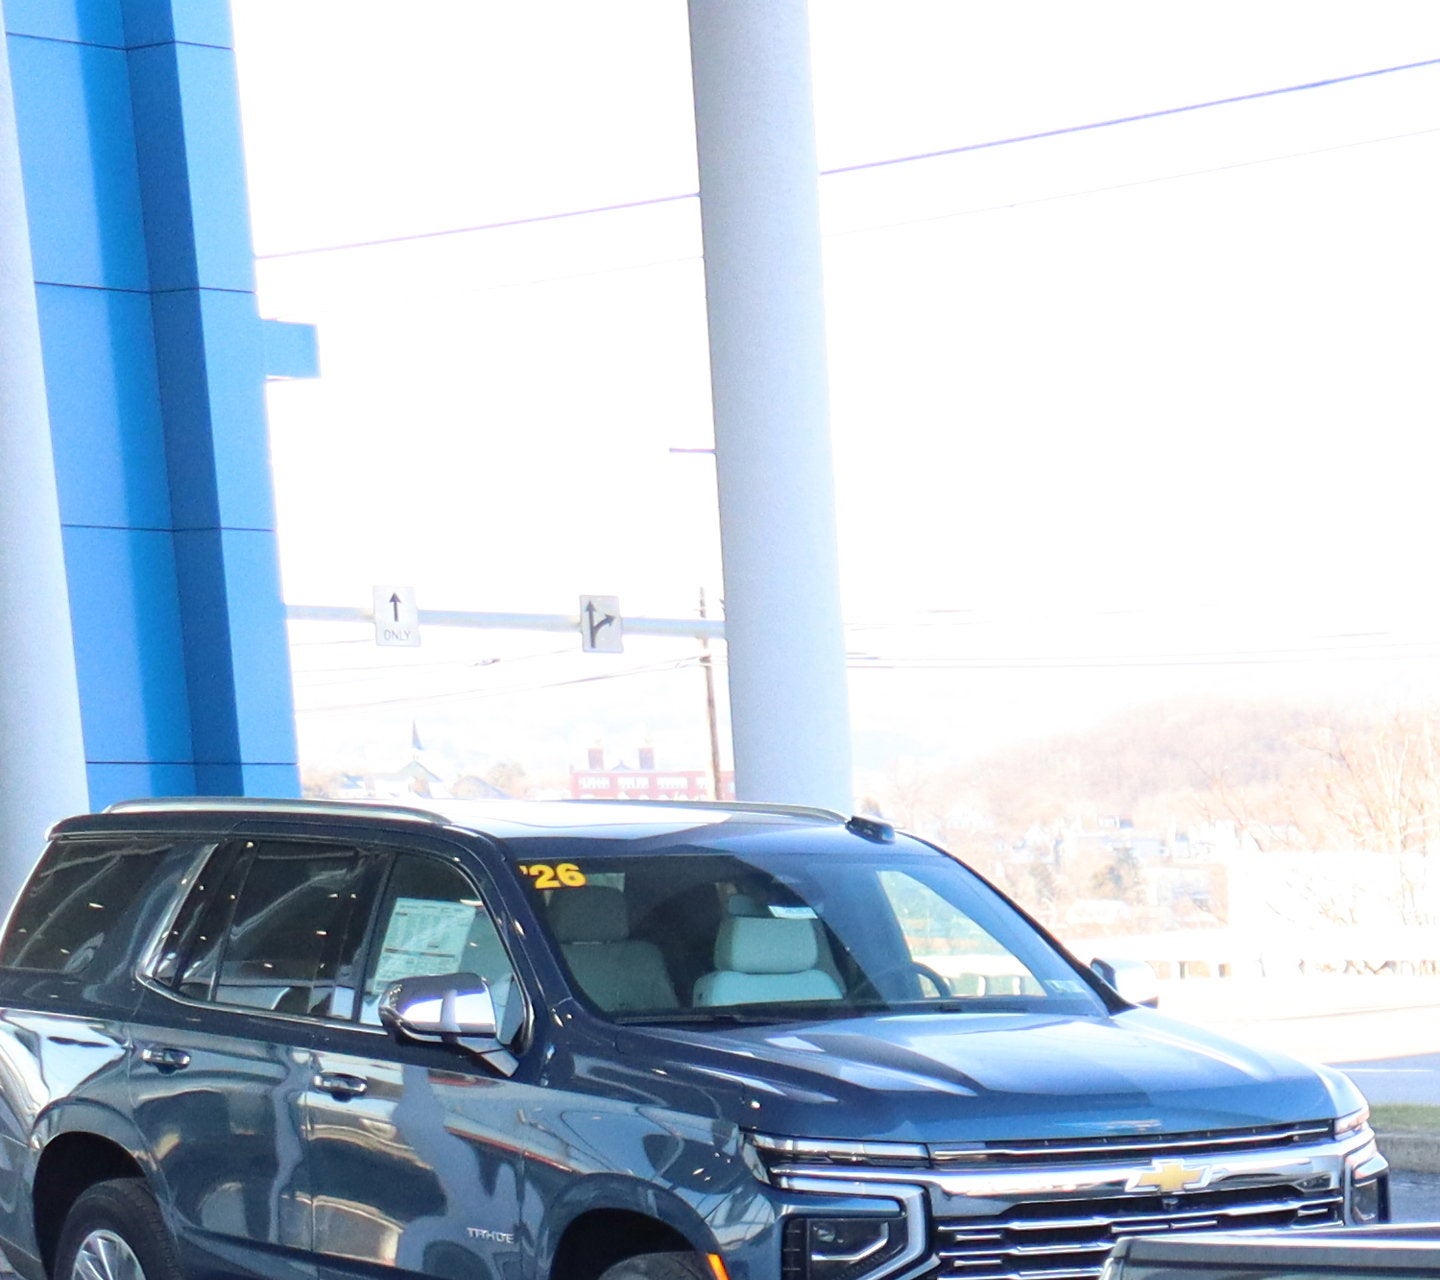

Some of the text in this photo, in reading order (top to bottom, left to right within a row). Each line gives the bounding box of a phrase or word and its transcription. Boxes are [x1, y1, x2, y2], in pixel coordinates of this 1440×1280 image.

[383, 629, 411, 641] ONLY
[519, 862, 587, 889] '26
[466, 1227, 515, 1244] TAHOE
